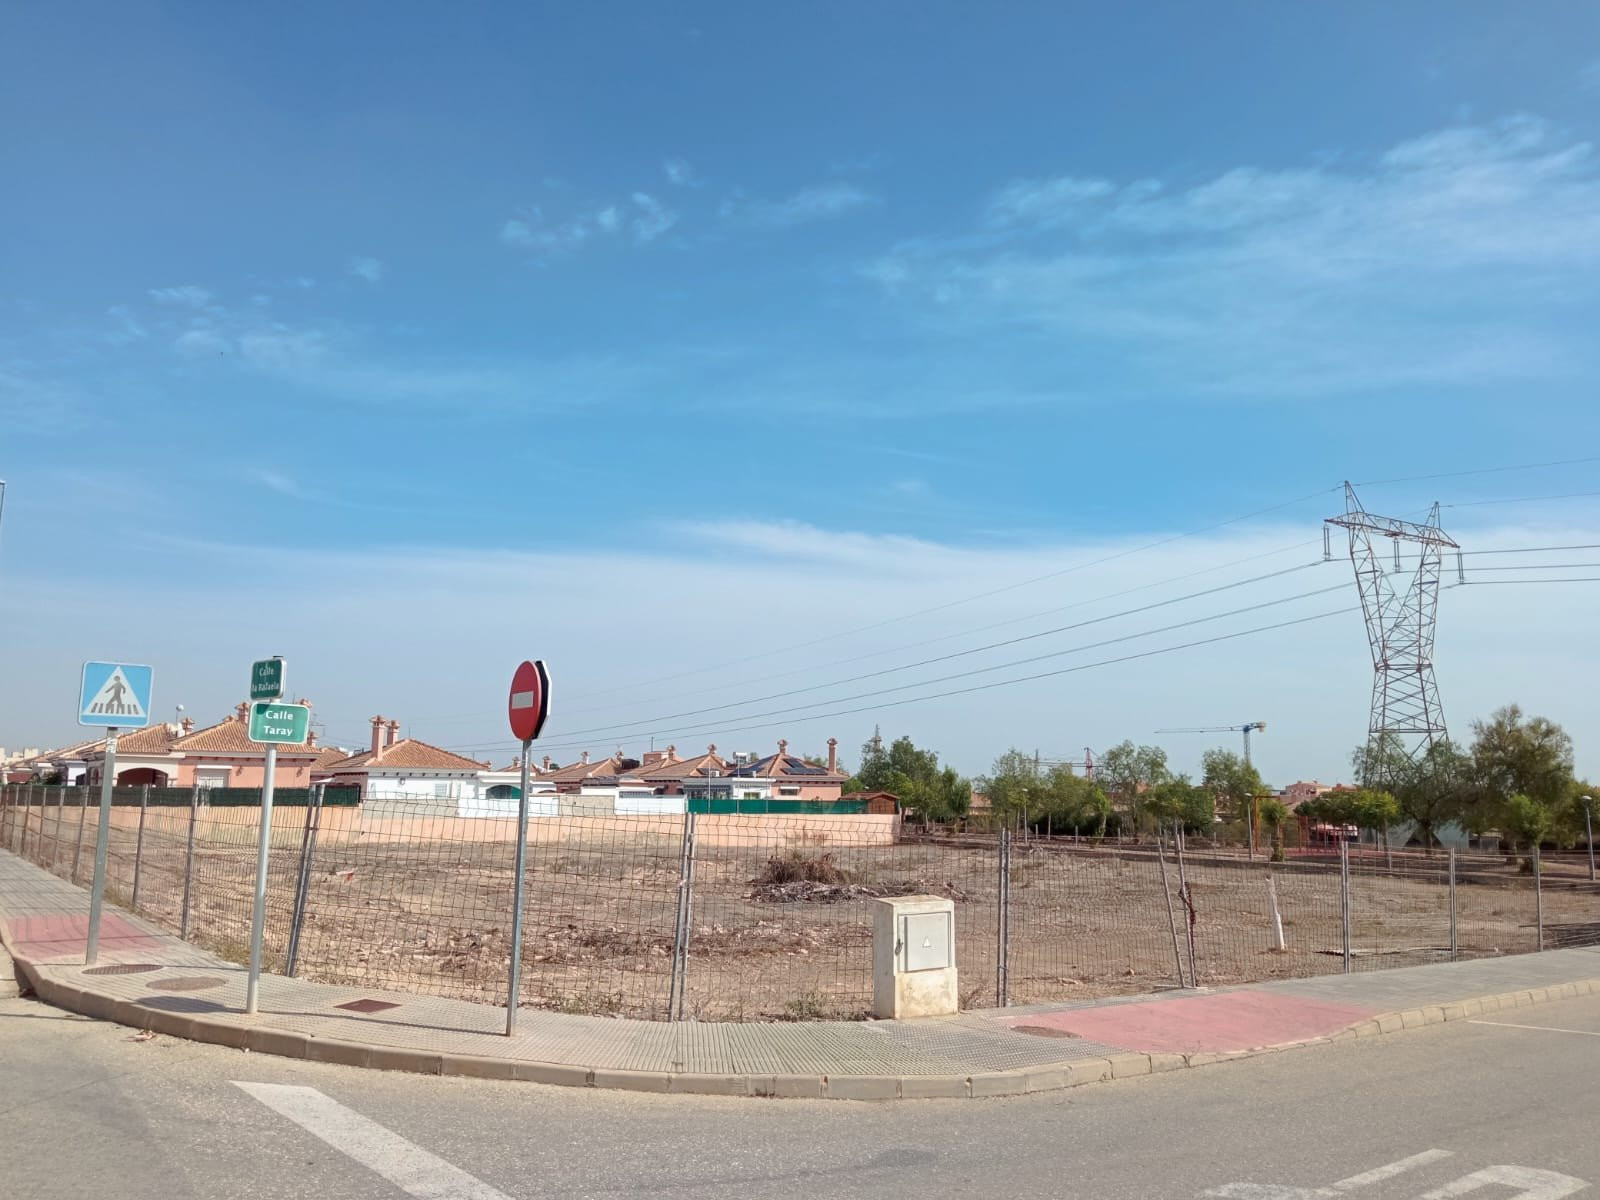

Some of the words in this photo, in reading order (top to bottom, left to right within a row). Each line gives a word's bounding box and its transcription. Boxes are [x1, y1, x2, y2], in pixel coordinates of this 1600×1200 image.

[259, 666, 275, 676] Calle
[265, 710, 294, 721] Calle
[264, 725, 293, 737] Taray
